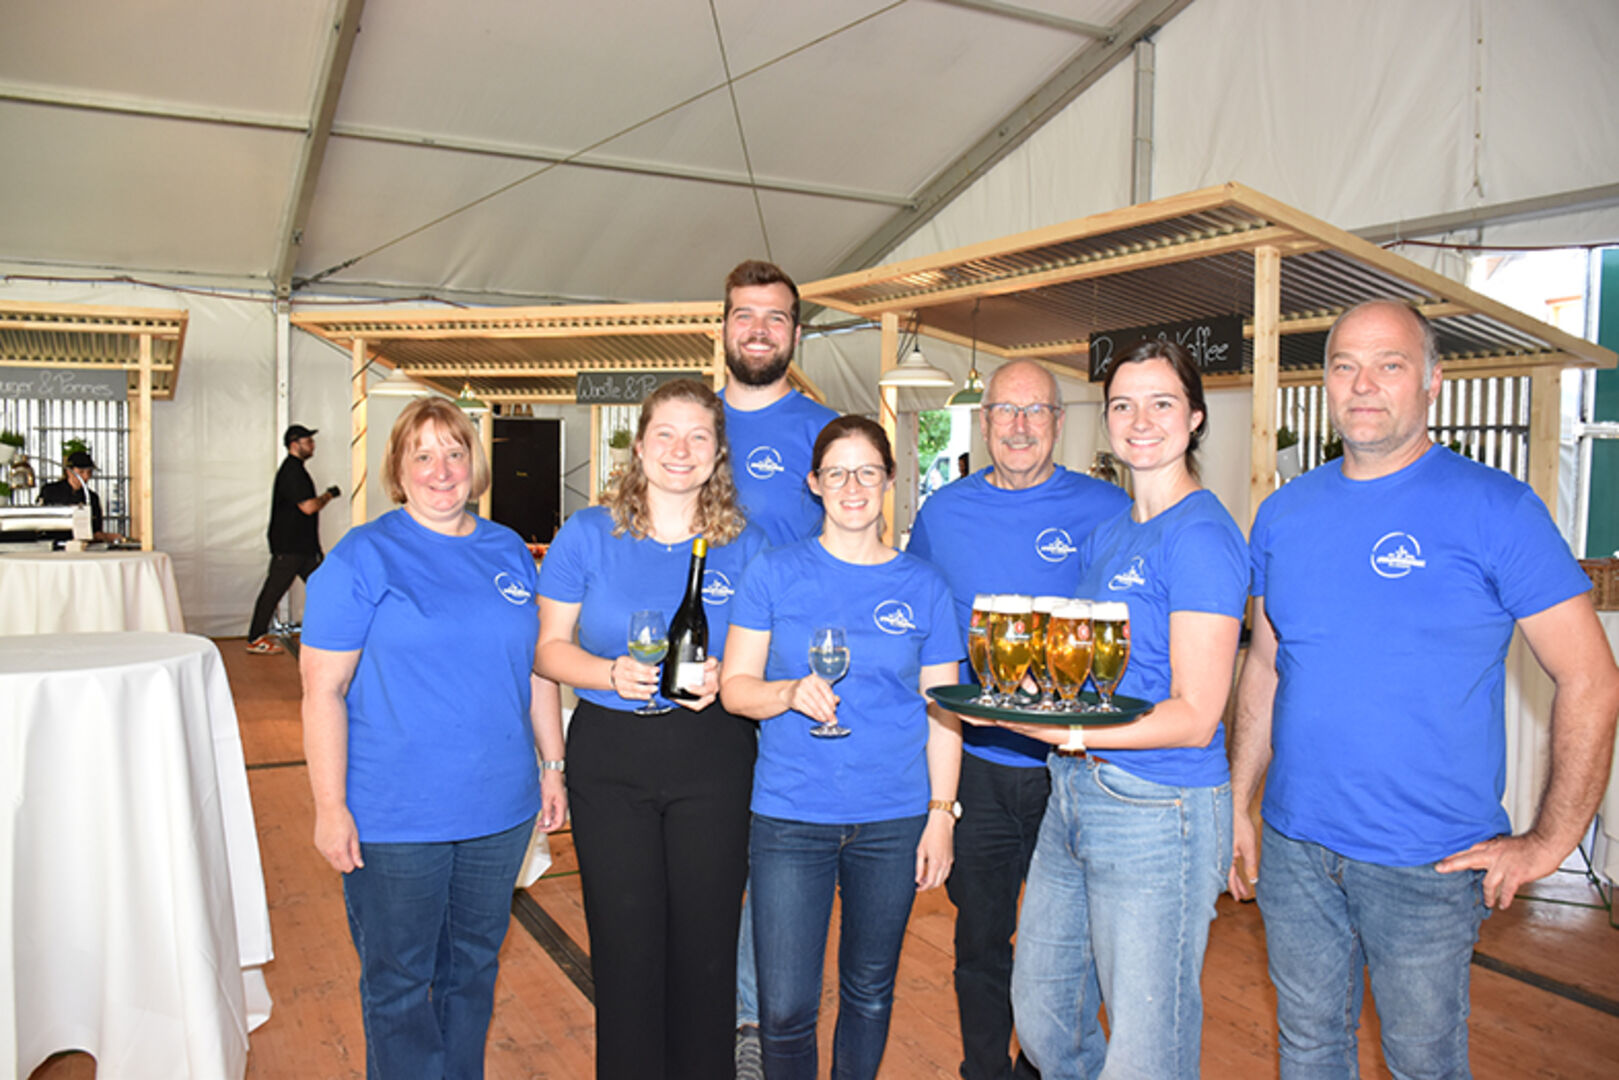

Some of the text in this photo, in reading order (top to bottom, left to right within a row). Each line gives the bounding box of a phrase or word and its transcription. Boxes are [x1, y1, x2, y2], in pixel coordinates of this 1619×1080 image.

[0, 381, 34, 398] urger
[38, 370, 54, 396] &
[624, 376, 639, 399] &
